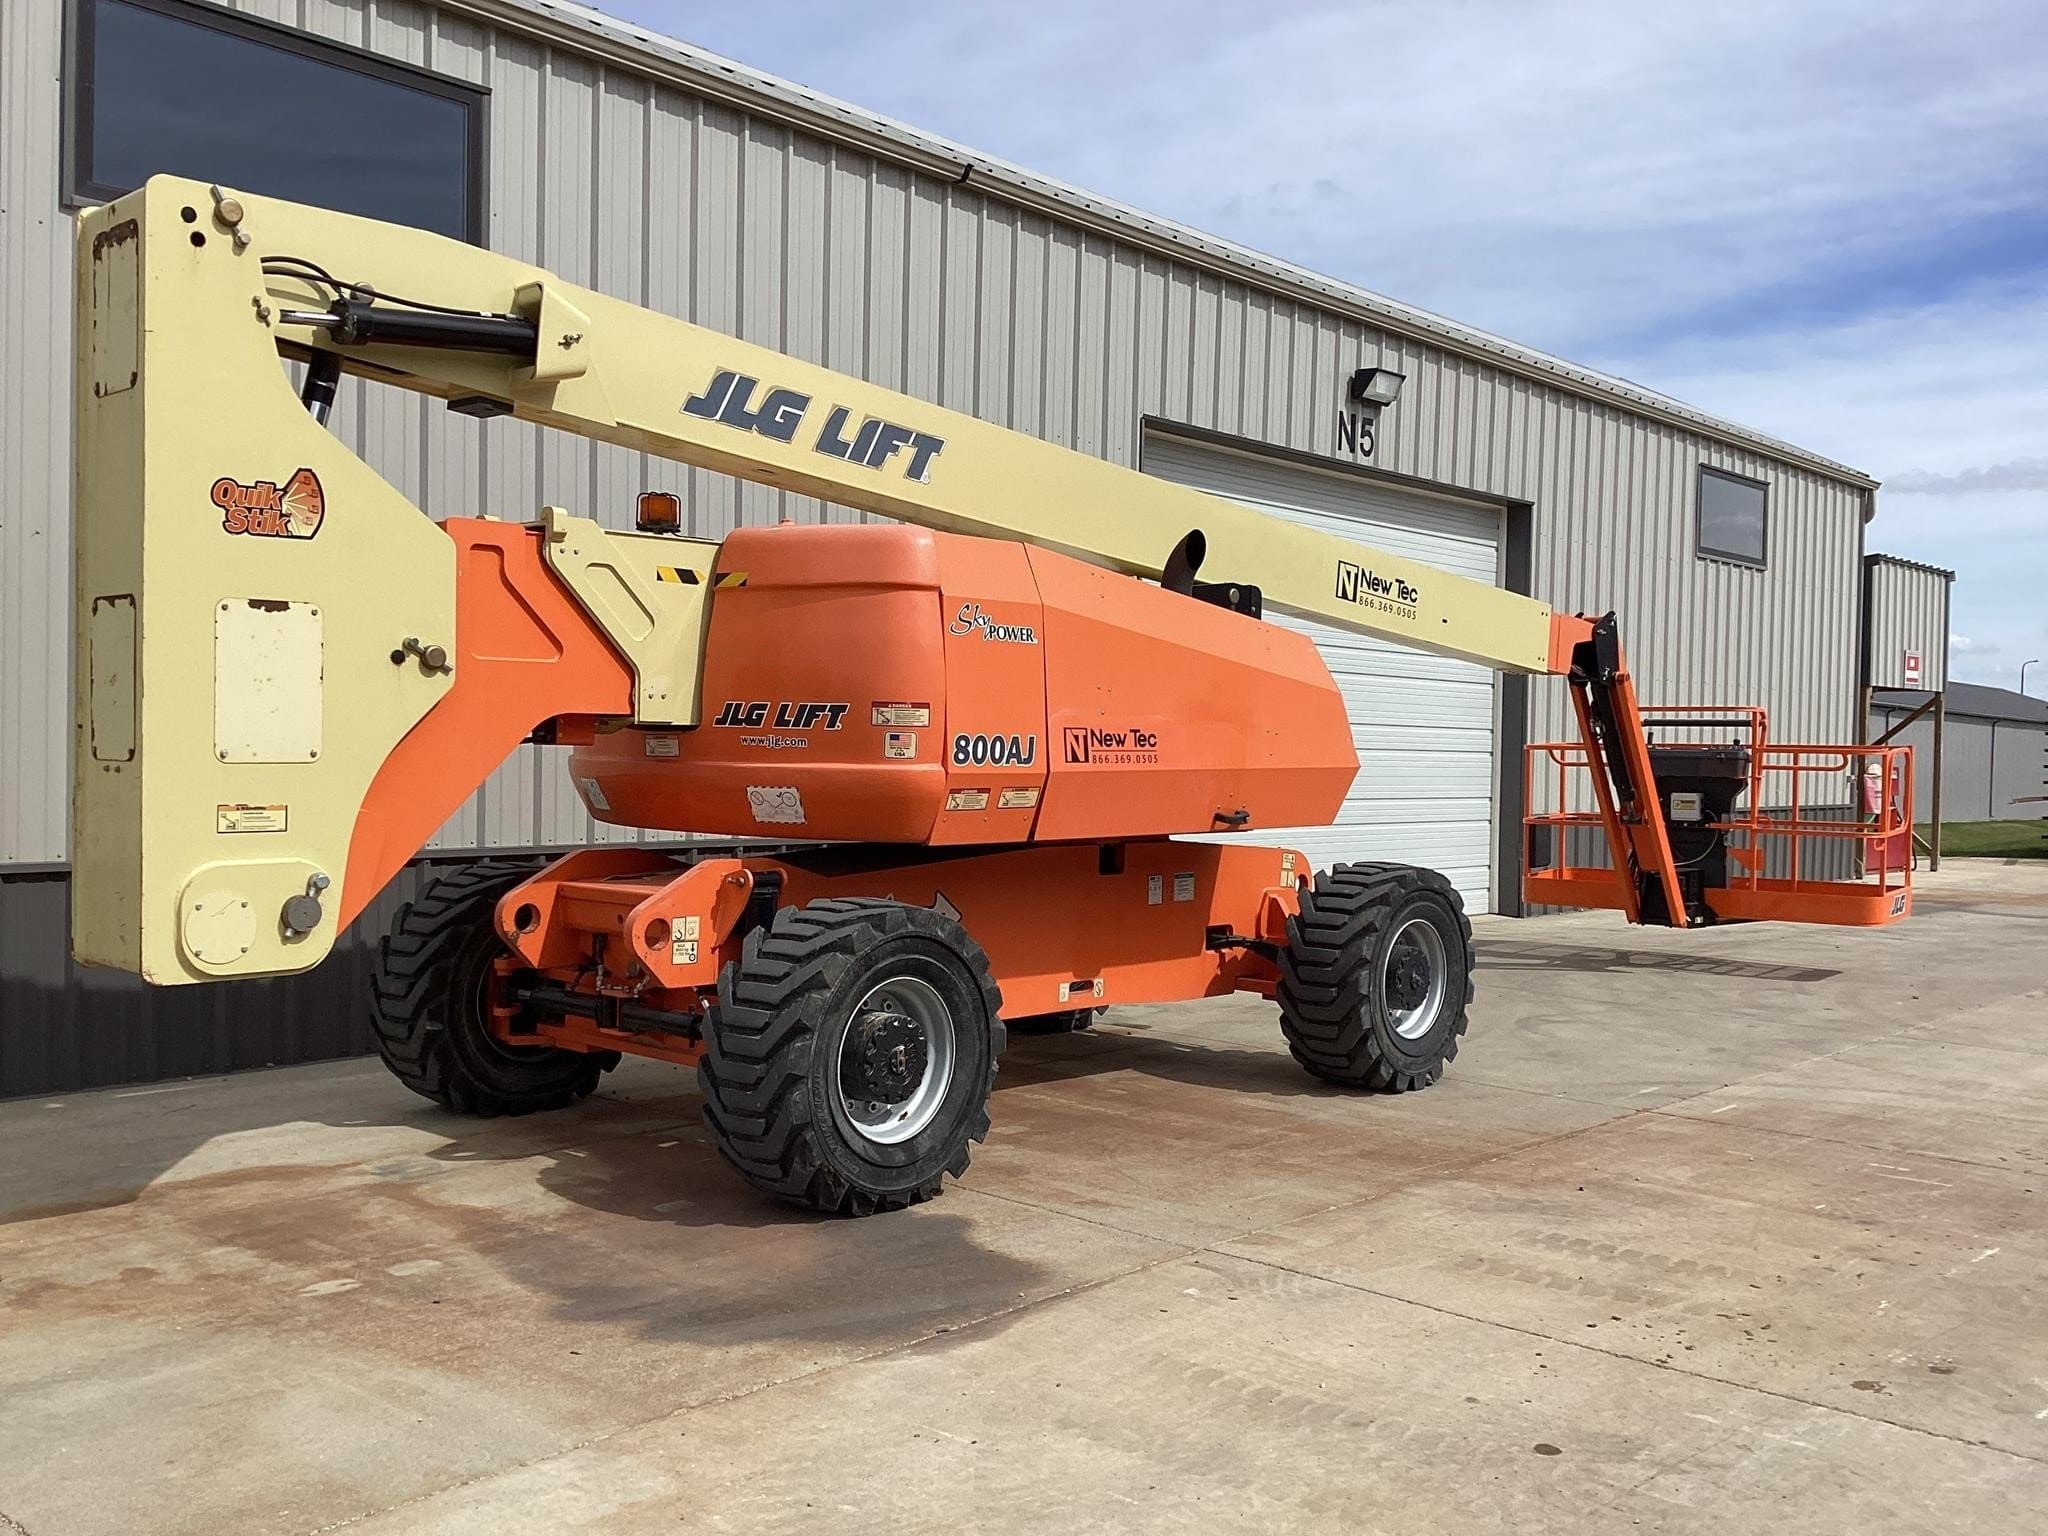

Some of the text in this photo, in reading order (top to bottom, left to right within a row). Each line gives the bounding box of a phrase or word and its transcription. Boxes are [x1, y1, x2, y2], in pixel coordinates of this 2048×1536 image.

[681, 371, 946, 482] JLG LIFT
[1337, 410, 1374, 457] N5
[212, 479, 284, 510] Quik
[224, 506, 290, 536] Stik
[1360, 568, 1418, 603] New Tec
[950, 603, 1034, 642] Sky POWER
[1358, 596, 1417, 620] 866.369.0505
[714, 702, 850, 730] JLG LIFT
[740, 735, 807, 748] www.jlg.com
[953, 734, 1035, 766] 800AJ
[1090, 728, 1158, 748] New Tec
[1092, 754, 1159, 764] 866.369.0505
